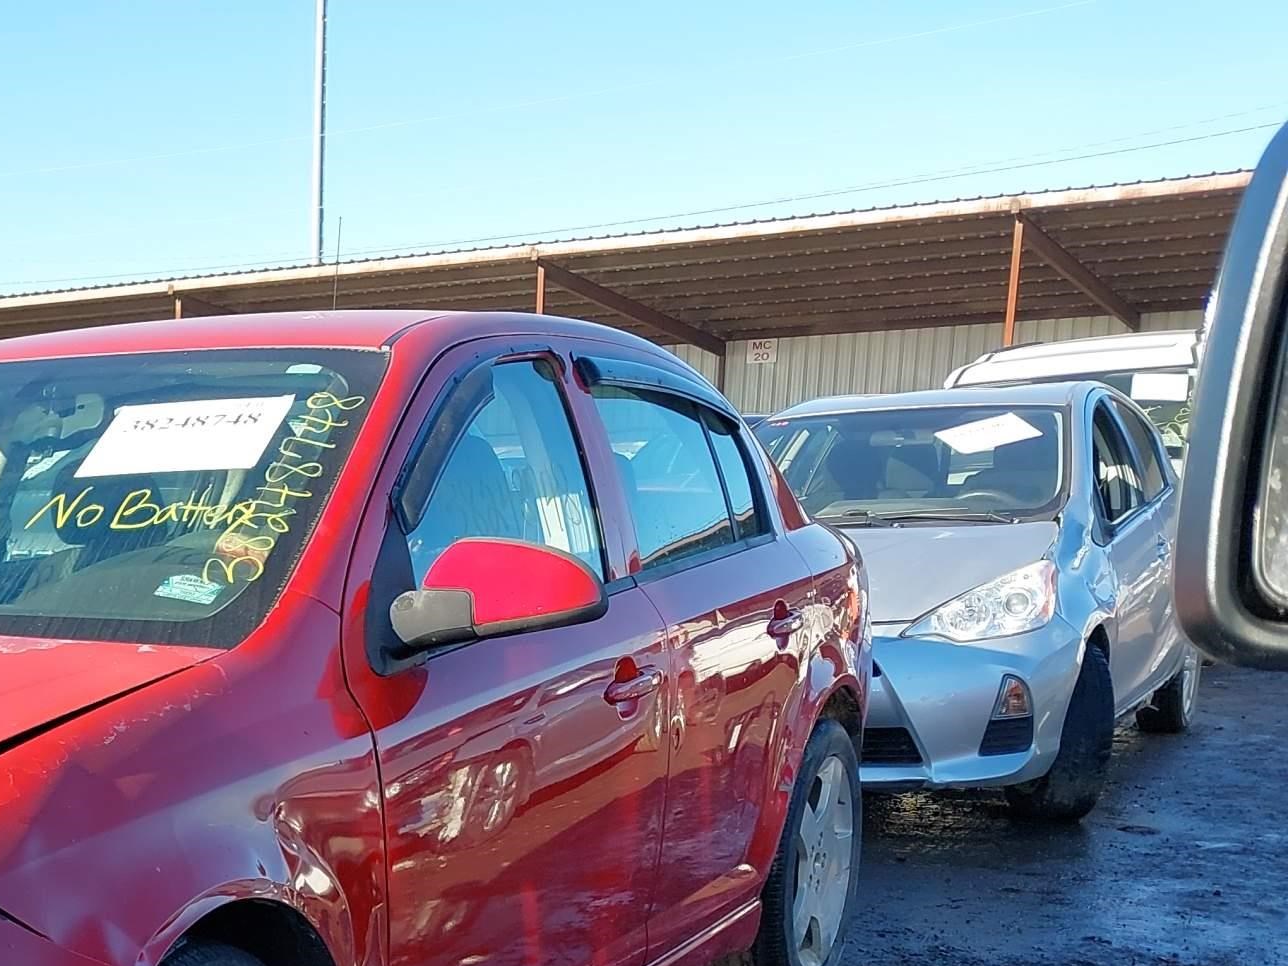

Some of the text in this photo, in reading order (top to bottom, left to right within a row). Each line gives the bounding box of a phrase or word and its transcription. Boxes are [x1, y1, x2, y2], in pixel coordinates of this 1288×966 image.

[752, 341, 772, 350] MC
[754, 352, 770, 361] 20
[123, 412, 263, 433] 38248748
[24, 486, 105, 530] No
